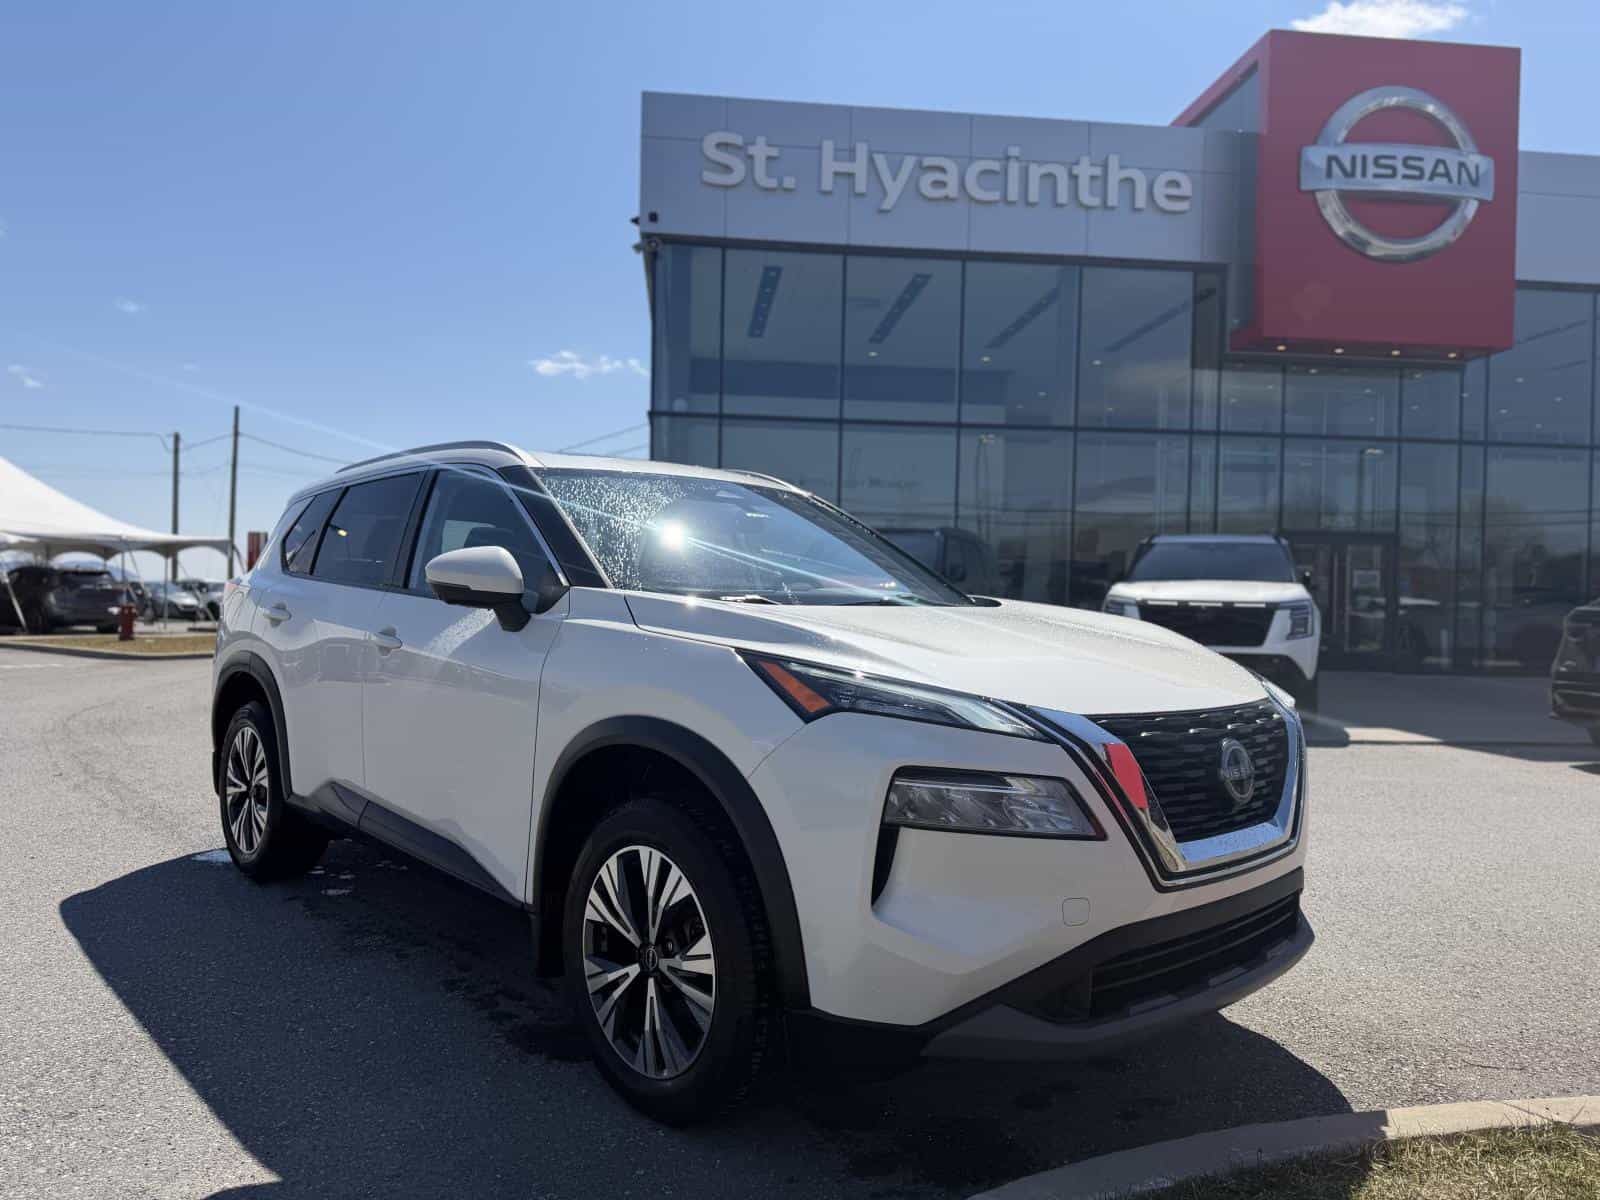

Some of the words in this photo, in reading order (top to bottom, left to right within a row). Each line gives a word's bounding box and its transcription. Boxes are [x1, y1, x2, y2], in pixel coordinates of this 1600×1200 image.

[701, 131, 796, 191] St.
[819, 139, 1193, 212] Hyacinthe
[1325, 154, 1480, 187] NISSAN
